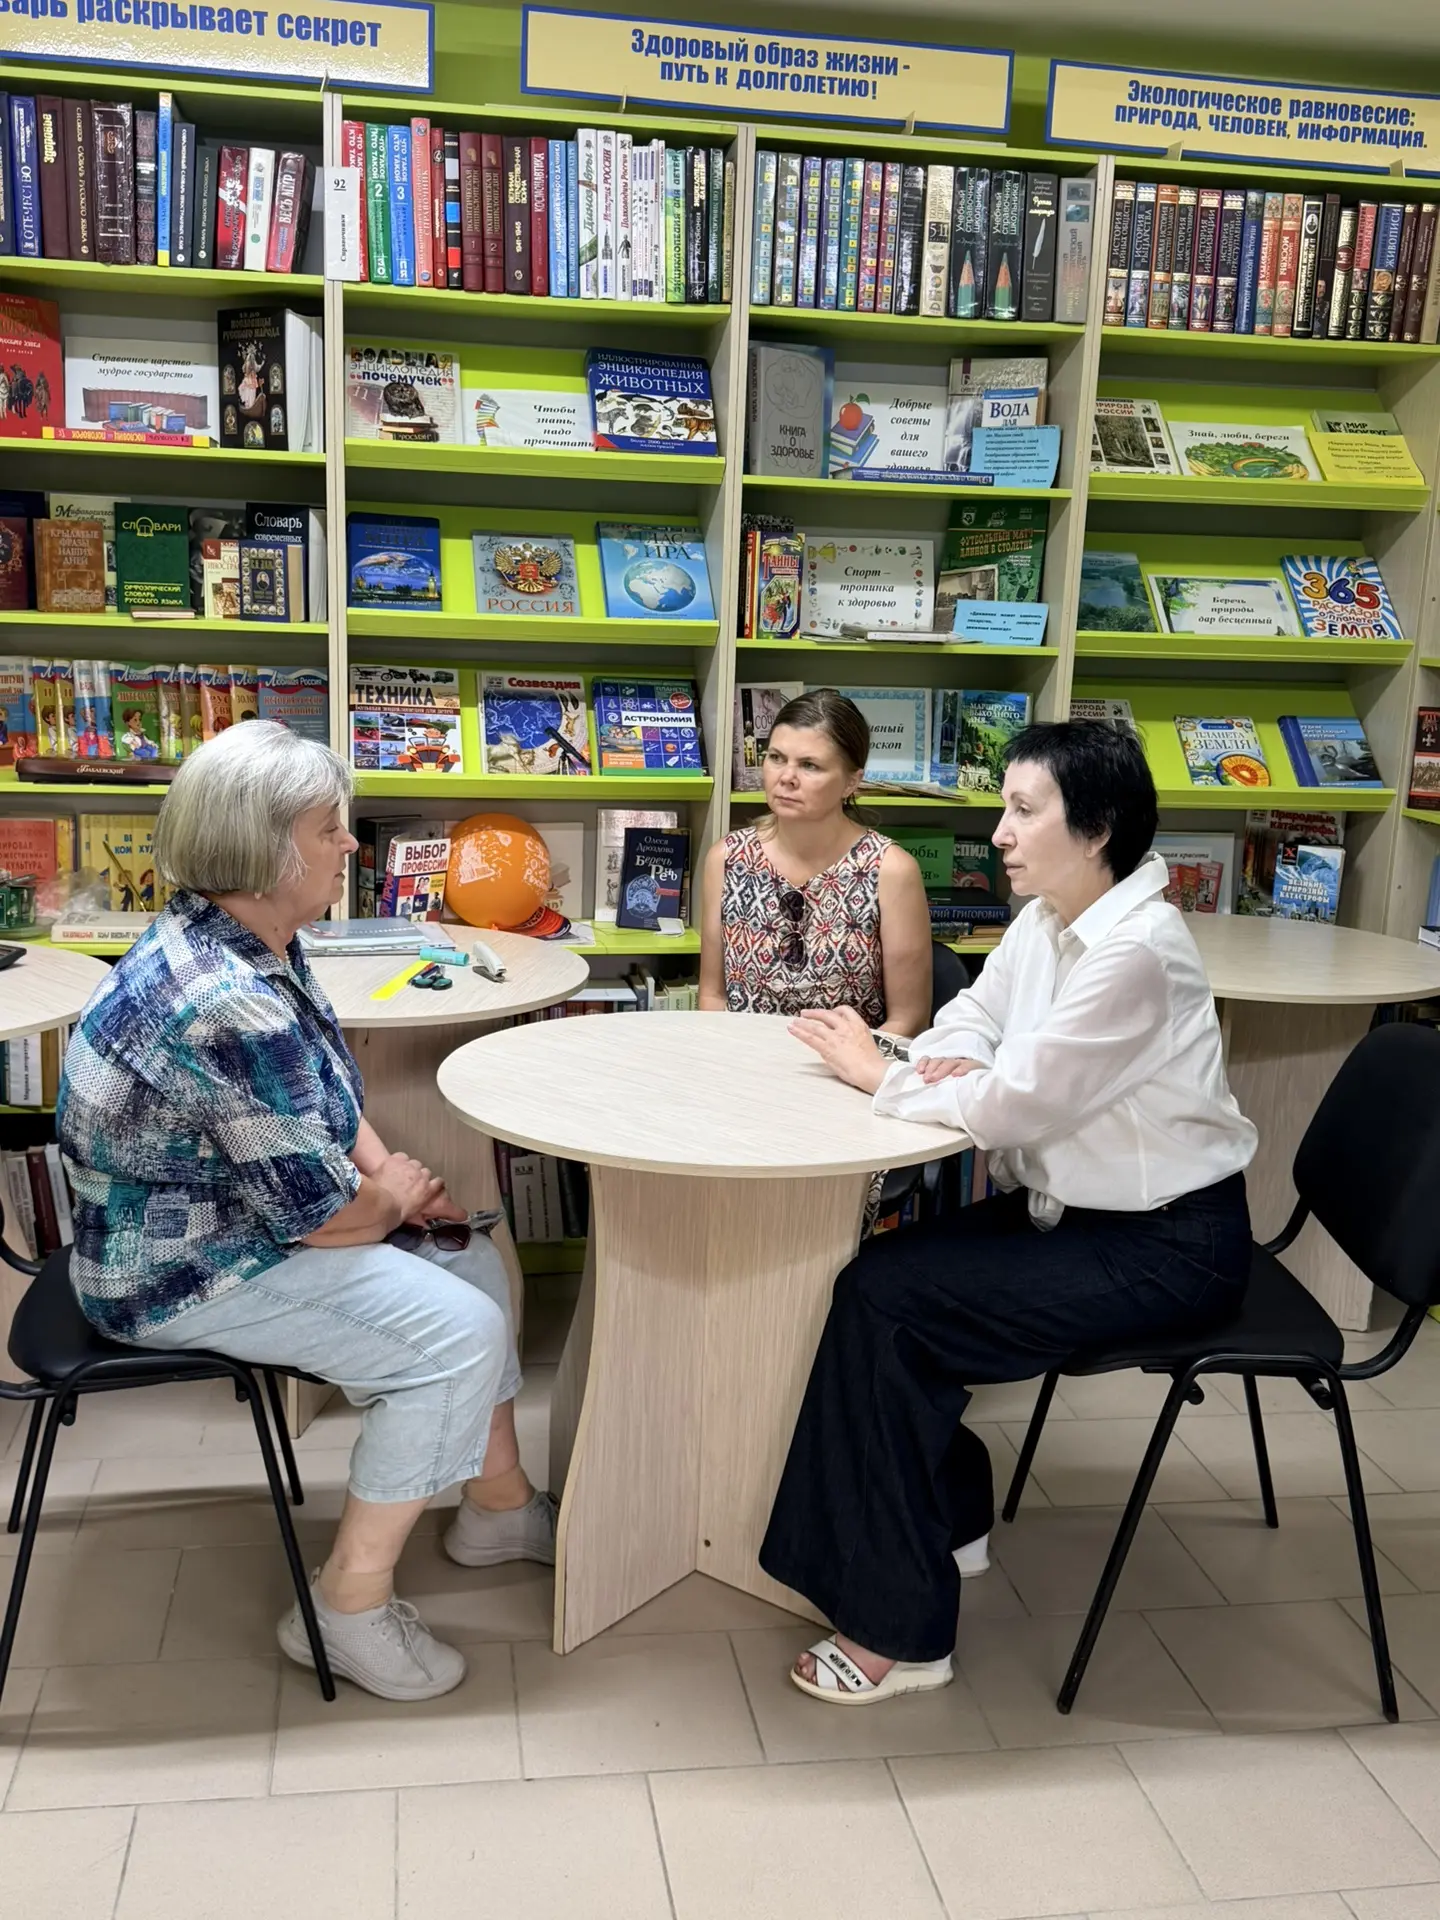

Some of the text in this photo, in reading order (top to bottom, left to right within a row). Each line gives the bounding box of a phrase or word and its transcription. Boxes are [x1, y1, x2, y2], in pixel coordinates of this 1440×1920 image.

[77, 0, 269, 36] раскрывает
[278, 13, 382, 47] секрет
[631, 28, 749, 62] Здоровый
[754, 42, 819, 69] образ
[660, 61, 878, 100] ПУТЬ К ДОЛГОЛЕТИЮ!
[1127, 80, 1416, 127] Экологическое равновесие:
[1115, 105, 1428, 150] ПРИРОДА, ЧЕЛОВЕК, ИНФОРМАЦИЯ.
[42, 113, 57, 163] Здоровье
[348, 129, 356, 147] КТО
[371, 150, 379, 179] ТАКОЙ
[394, 154, 402, 182] ТАКОЙ
[603, 149, 612, 186] РОССИИ
[333, 179, 346, 189] 92
[375, 183, 383, 197] 2
[533, 153, 545, 213] КОСМОНАВТИКА
[397, 186, 405, 200] 3
[278, 199, 293, 224] ВЕСЬ
[620, 181, 629, 229] Полководцы
[955, 190, 966, 232] Учебный
[966, 177, 975, 232] справочник
[973, 179, 984, 234] школьника
[1003, 180, 1012, 234] справочник
[1010, 183, 1019, 235] школьника
[993, 192, 1003, 234] Учебный
[1159, 206, 1168, 237] ИСТОРИЯ
[1112, 211, 1122, 255] ИСТОРИЯ
[1134, 214, 1145, 258] ИСТОРИЯ
[1141, 209, 1152, 263] РЫЦАРСТВА
[1176, 217, 1187, 261] ИСТОРИЯ
[1362, 213, 1375, 260] МУЗЫКИ
[1385, 208, 1401, 267] ЖИВОПИСИ
[1198, 219, 1208, 263] ИСТОРИЯ
[1204, 209, 1216, 273] ИНКВИЗИЦИИ
[1219, 222, 1229, 261] ИСТОРИЯ
[1231, 210, 1242, 275] ПРЕСТУПЛЕНИЙ
[1118, 235, 1128, 267] ТАЙНЫХ
[1280, 236, 1290, 275] МОСКВЫ
[91, 353, 191, 367] Справочное царство
[350, 346, 453, 370] БОЛЬШАЯ
[598, 352, 704, 370] ИЛЛЮСТРИРОВАННАЯ
[97, 366, 193, 379] мудрое государство
[350, 362, 454, 378] ЭНЦИКЛОПЕДИЯ
[598, 362, 703, 380] ЭНЦИКЛОПЕДИЯ
[598, 374, 704, 394] ЖИВОТНЫХ
[533, 404, 576, 416] Чтобы
[889, 398, 933, 410] Добрые
[1097, 408, 1134, 416] РОССИИ
[536, 416, 576, 427] знать,
[890, 417, 930, 427] советы
[543, 427, 571, 437] надо
[779, 424, 807, 438] КНИГА
[900, 432, 919, 442] для
[1187, 429, 1290, 443] Знай, люби, береги
[523, 438, 595, 448] прочитать
[789, 436, 797, 447] О
[770, 445, 814, 460] ЗДОРОВЬЕ
[890, 449, 928, 459] вашего
[254, 512, 303, 532] Словарь
[50, 530, 100, 539] КРЫЛАТЫЕ
[60, 538, 90, 546] ФРАЗЫ
[254, 533, 302, 543] современных
[58, 548, 93, 556] НАШИХ
[62, 556, 88, 565] ДНЕЙ
[844, 567, 881, 578] Спорт
[839, 583, 894, 594] тропинка
[1302, 571, 1382, 610] 365
[124, 597, 184, 606] РУССКОГО ЯЗЫКА
[487, 598, 574, 614] РОССИЯ
[846, 598, 896, 609] здоровью
[1212, 596, 1246, 604] Беречь
[1210, 605, 1255, 615] природы
[1312, 600, 1382, 619] РАССКАЗОВ
[1198, 615, 1273, 626] дар бесценный
[1327, 613, 1374, 626] планете
[1314, 619, 1389, 639] ЗЕМЛЯ
[507, 676, 581, 691] Созвездия
[355, 684, 436, 706] ТЕХНИКА
[970, 702, 1016, 712] МАРШРУТЫ
[970, 709, 1020, 719] ВЫХОДНОГО
[1071, 710, 1105, 718] РОССИИ
[624, 715, 692, 723] АСТРОНОМИЯ
[1194, 731, 1244, 739] ПЛАНЕТА
[1193, 738, 1251, 750] ЗЕМЛЯ
[1270, 810, 1336, 825] Природные
[1270, 821, 1337, 836] катастрофы
[644, 835, 669, 845] Олеся
[405, 843, 447, 861] ВЫБОР
[636, 843, 674, 853] Дроздова
[954, 843, 989, 860] СПИД
[401, 859, 448, 874] ПРОФЕССИИ
[635, 854, 673, 866] Беречь
[649, 864, 678, 881] Речь
[1279, 891, 1330, 903] КАТАСТРОФЫ
[1282, 885, 1328, 896] ПРИРОДНЫЕ
[952, 908, 1005, 919] ГРИГОРОВИЧ
